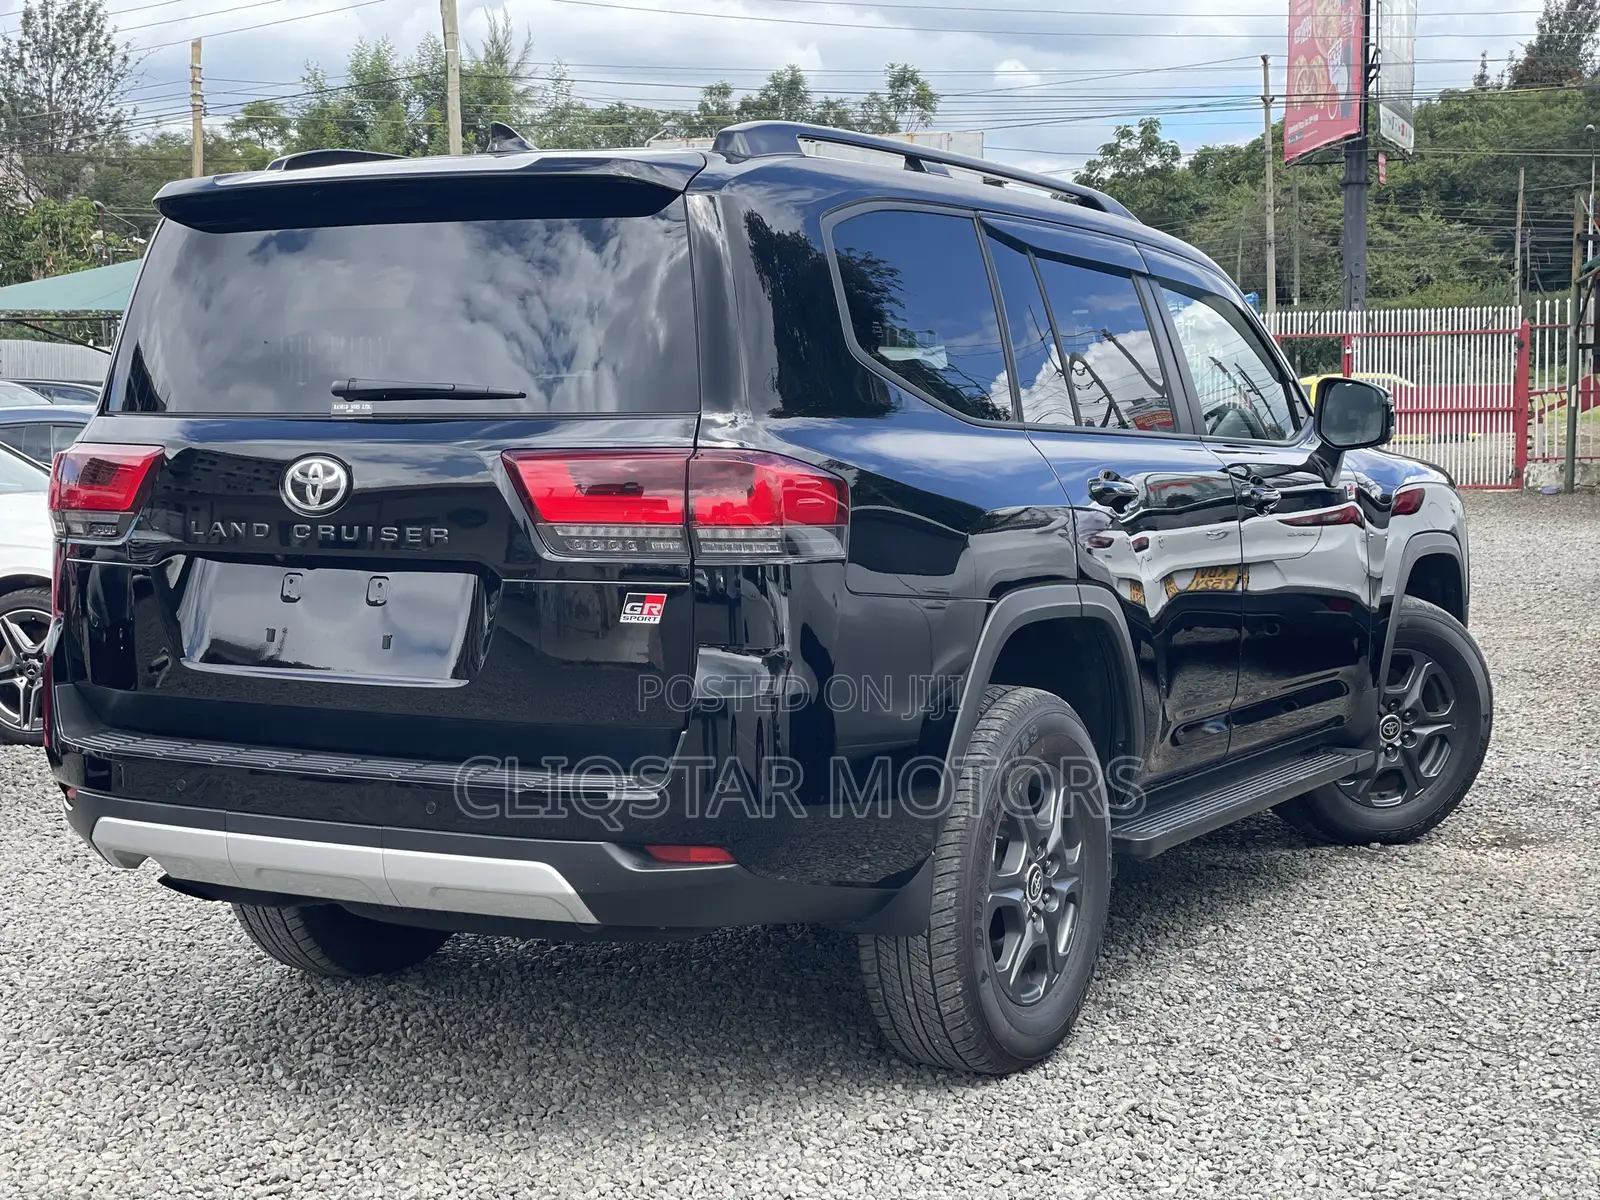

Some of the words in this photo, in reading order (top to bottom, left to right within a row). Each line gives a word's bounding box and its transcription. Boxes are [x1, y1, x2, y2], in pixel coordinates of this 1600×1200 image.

[190, 520, 270, 538] LAND
[292, 524, 449, 544] CRUISER
[624, 602, 662, 615] GR
